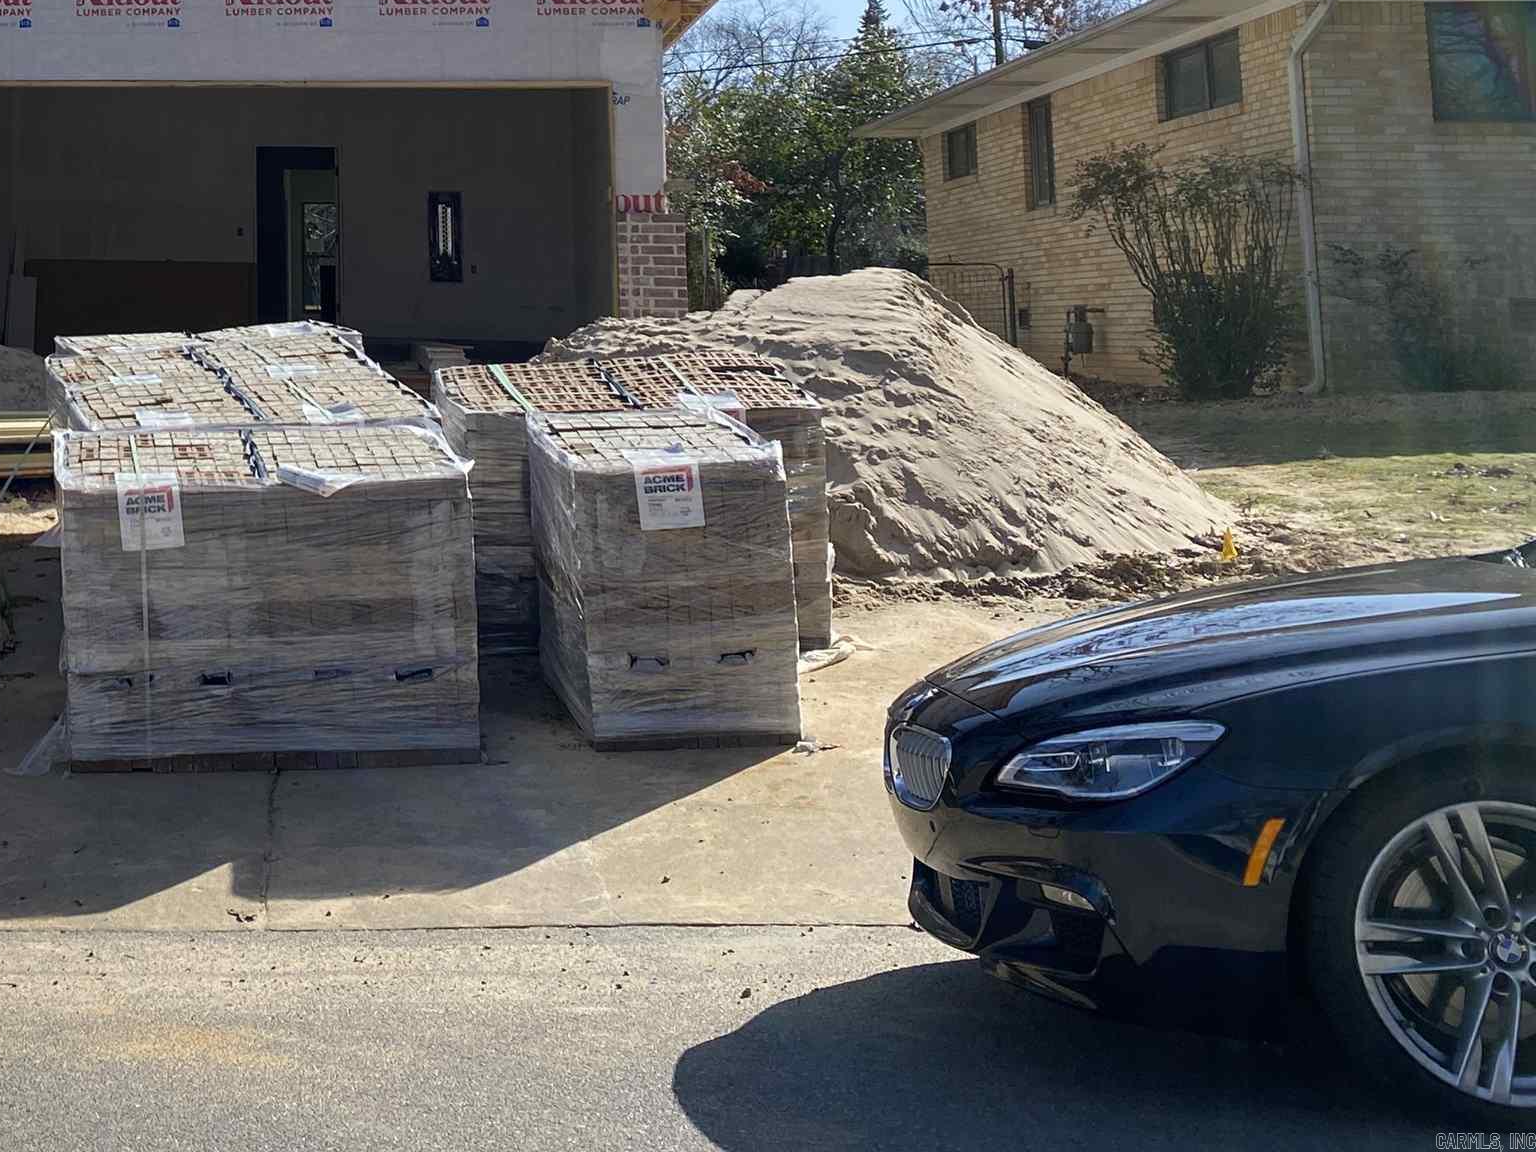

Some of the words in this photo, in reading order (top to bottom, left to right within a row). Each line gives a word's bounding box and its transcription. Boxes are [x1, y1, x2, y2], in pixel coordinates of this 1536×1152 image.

[76, 8, 122, 17] LUMBER
[126, 7, 181, 17] COMPANY
[225, 7, 272, 16] LUMBER
[276, 6, 334, 16] COMPANY
[379, 7, 427, 16] LUMBER
[431, 6, 491, 16] COMPANY
[537, 7, 585, 16] LUMBER
[591, 6, 644, 16] COMPAN
[644, 474, 685, 484] ACME
[644, 484, 686, 494] BRICK
